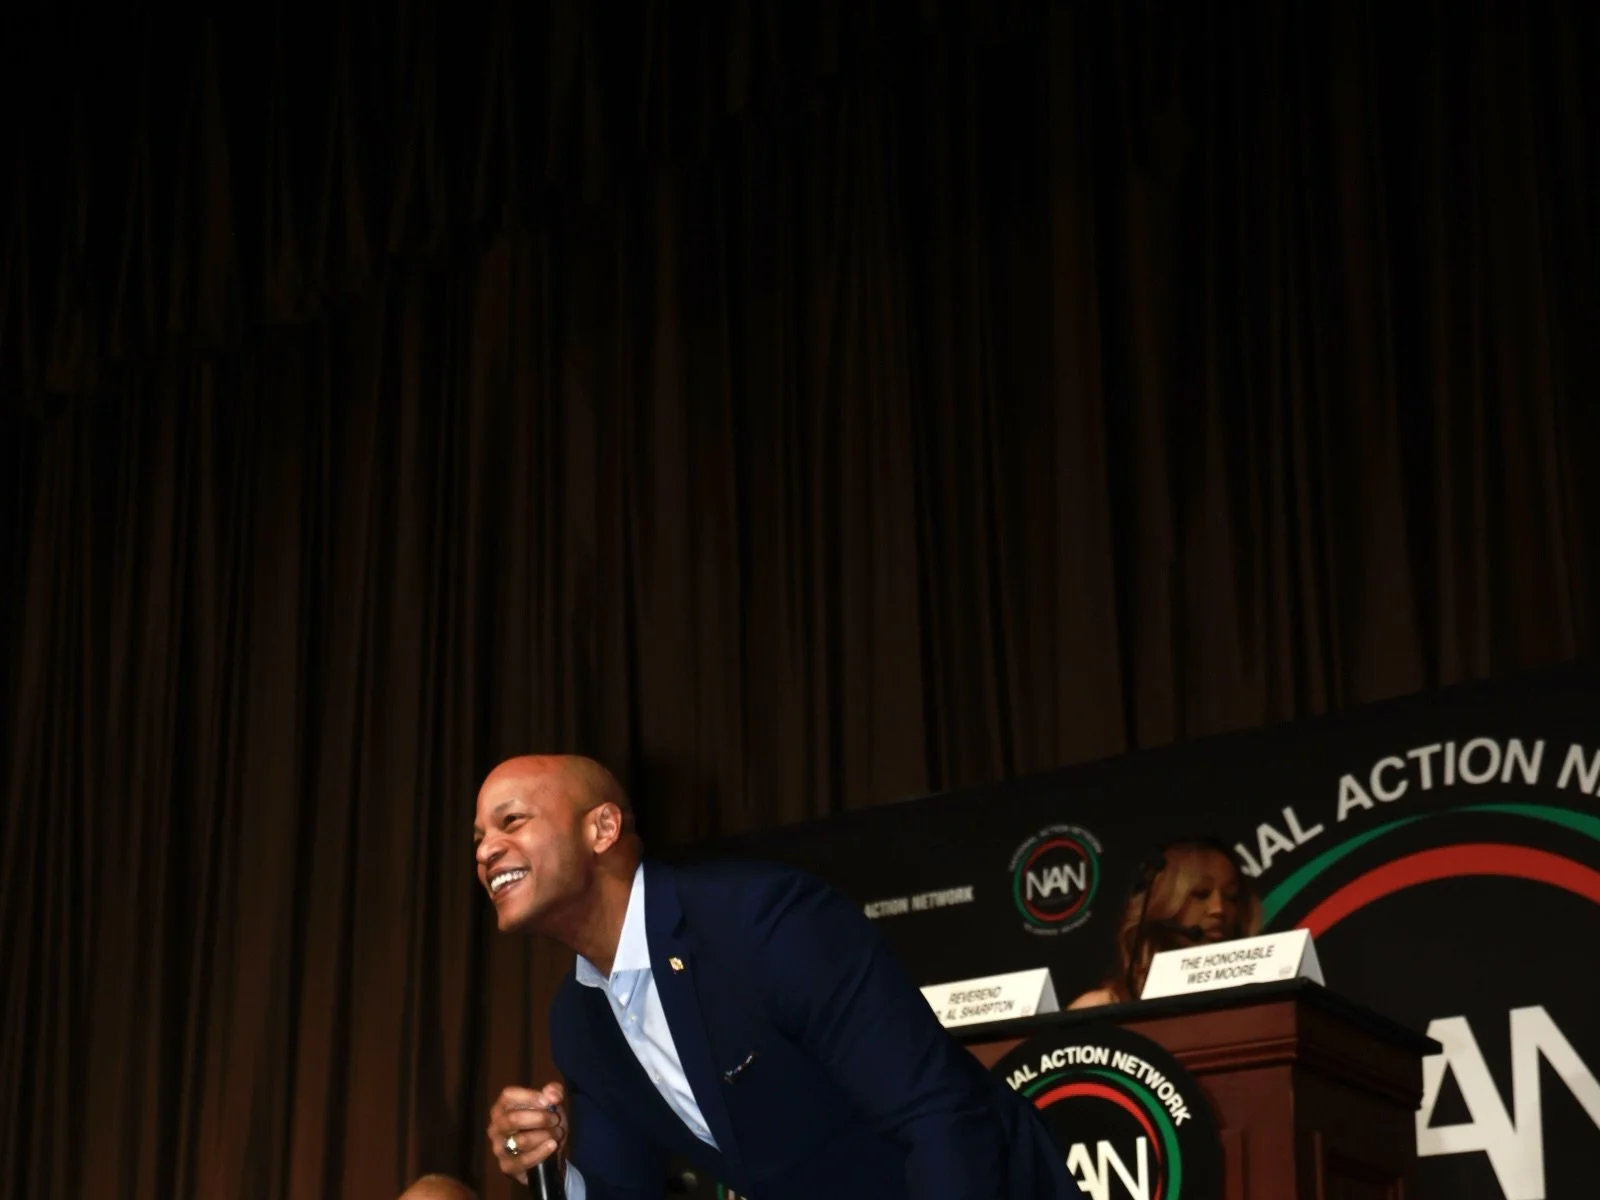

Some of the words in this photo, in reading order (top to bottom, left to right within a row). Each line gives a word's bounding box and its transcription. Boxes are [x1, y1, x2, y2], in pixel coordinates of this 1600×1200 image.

[1336, 737, 1546, 822] ACTION
[1556, 743, 1600, 798] N
[1025, 861, 1086, 901] NAN
[911, 885, 974, 911] NETWORK
[1180, 956, 1202, 970] THE
[1203, 945, 1275, 968] HONORABLE
[1187, 970, 1212, 984] WES
[1214, 963, 1257, 980] MOORE
[948, 986, 1003, 1005] REVEREND
[959, 1000, 1015, 1019] SHARPTON
[1040, 1045, 1110, 1074] ACTION
[1111, 1050, 1192, 1126] NETWORK
